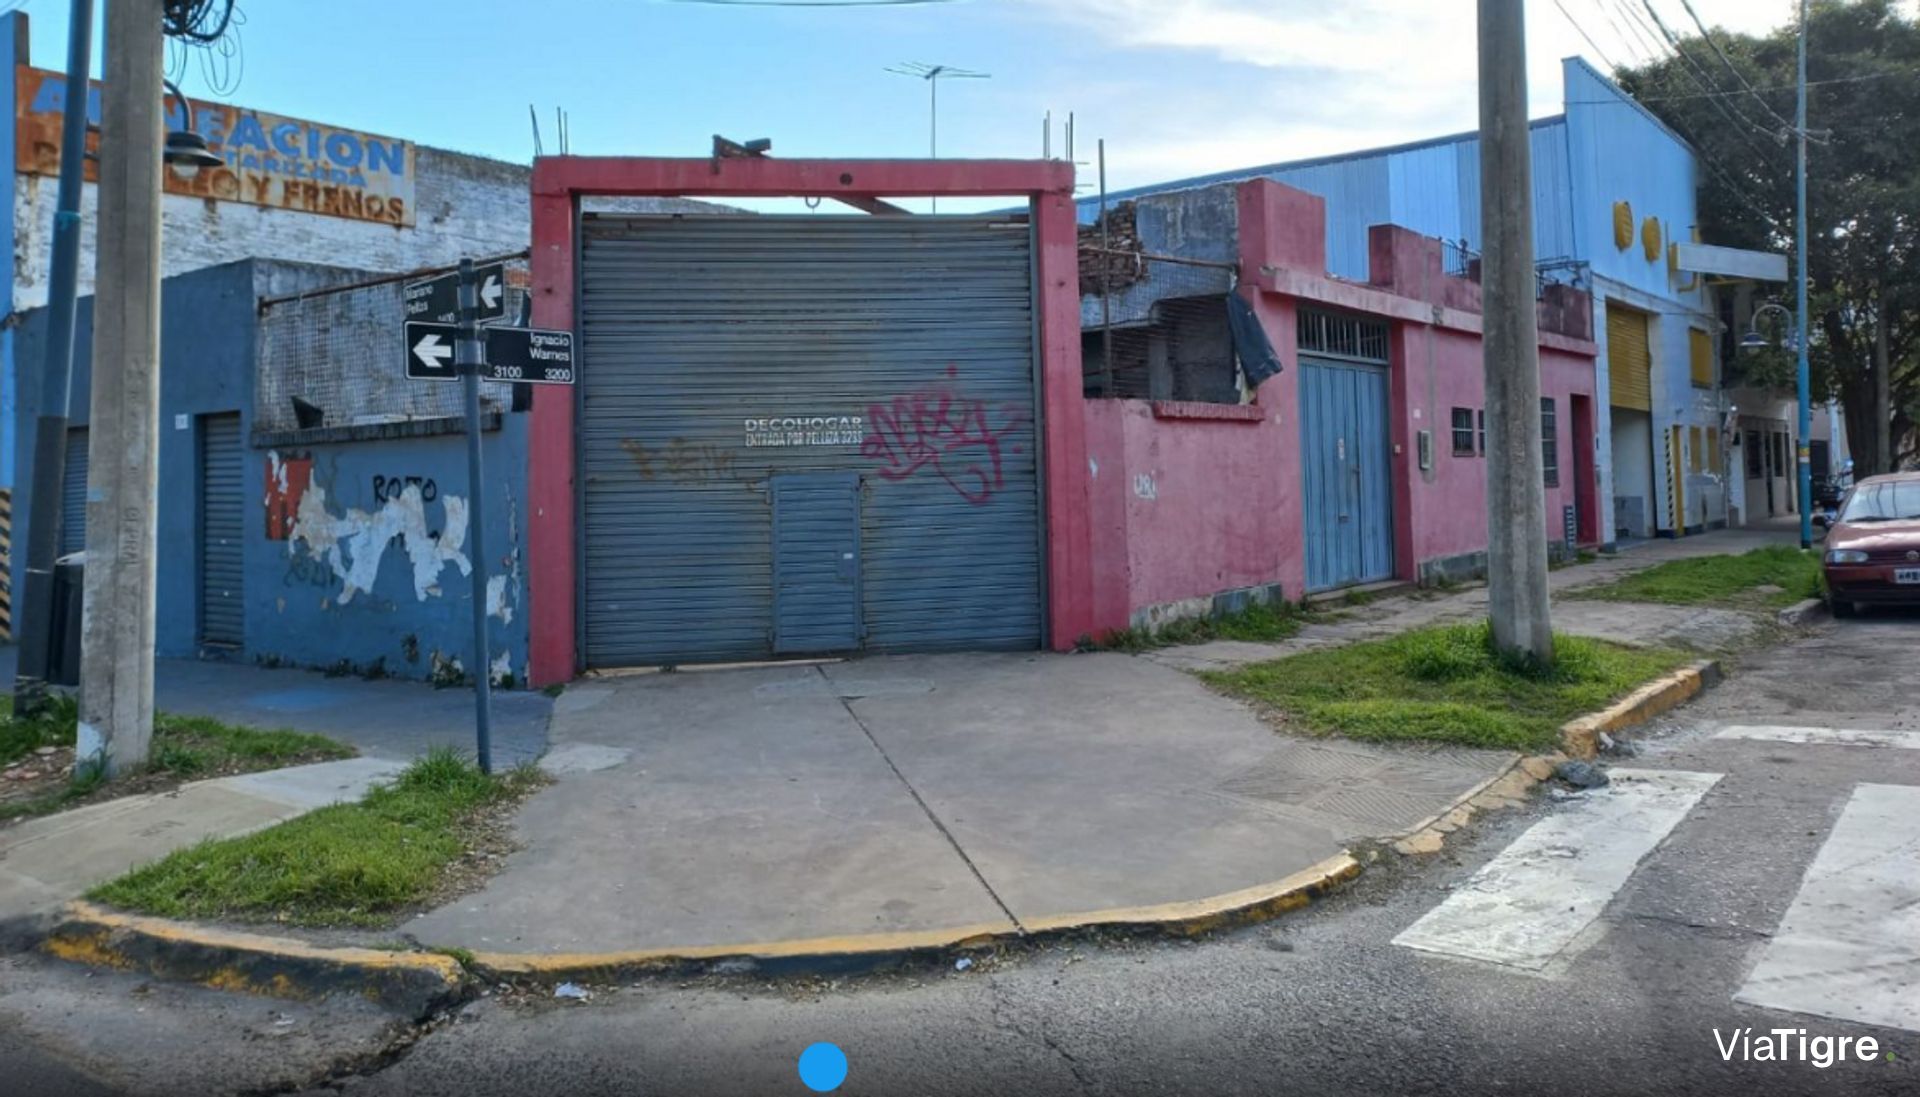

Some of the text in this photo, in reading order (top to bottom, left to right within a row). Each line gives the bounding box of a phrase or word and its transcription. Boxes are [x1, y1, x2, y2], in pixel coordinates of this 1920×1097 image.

[284, 179, 403, 221] FRENOS
[530, 332, 569, 346] Ignacio
[529, 347, 569, 361] Warnes
[494, 365, 571, 380] 3100 3200
[745, 416, 862, 431] DECOHOGAR
